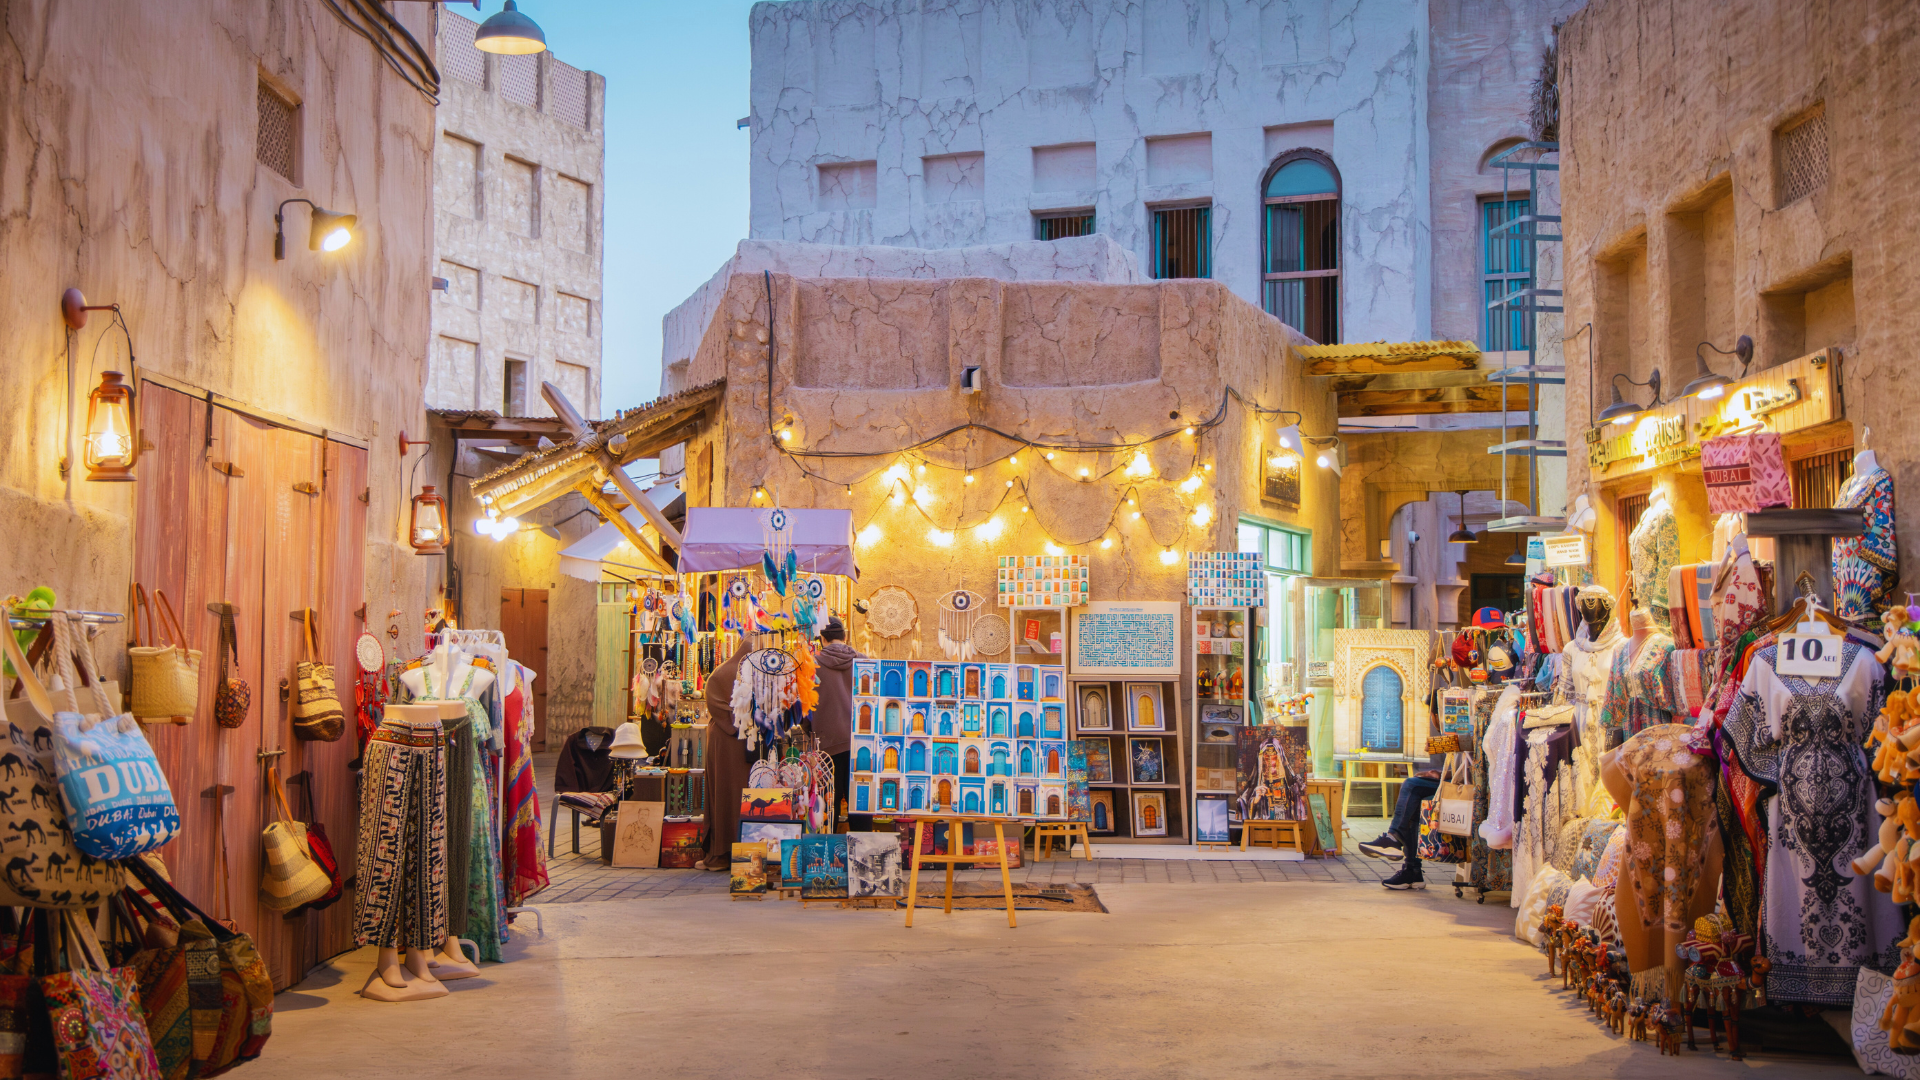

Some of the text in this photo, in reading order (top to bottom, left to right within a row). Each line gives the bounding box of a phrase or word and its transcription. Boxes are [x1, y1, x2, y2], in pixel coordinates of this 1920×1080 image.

[1584, 427, 1601, 443] THE
[1709, 470, 1741, 483] DUBAI
[1782, 637, 1838, 663] 10 AED
[87, 808, 134, 831] DUBAI
[1442, 812, 1465, 825] DUBAI
